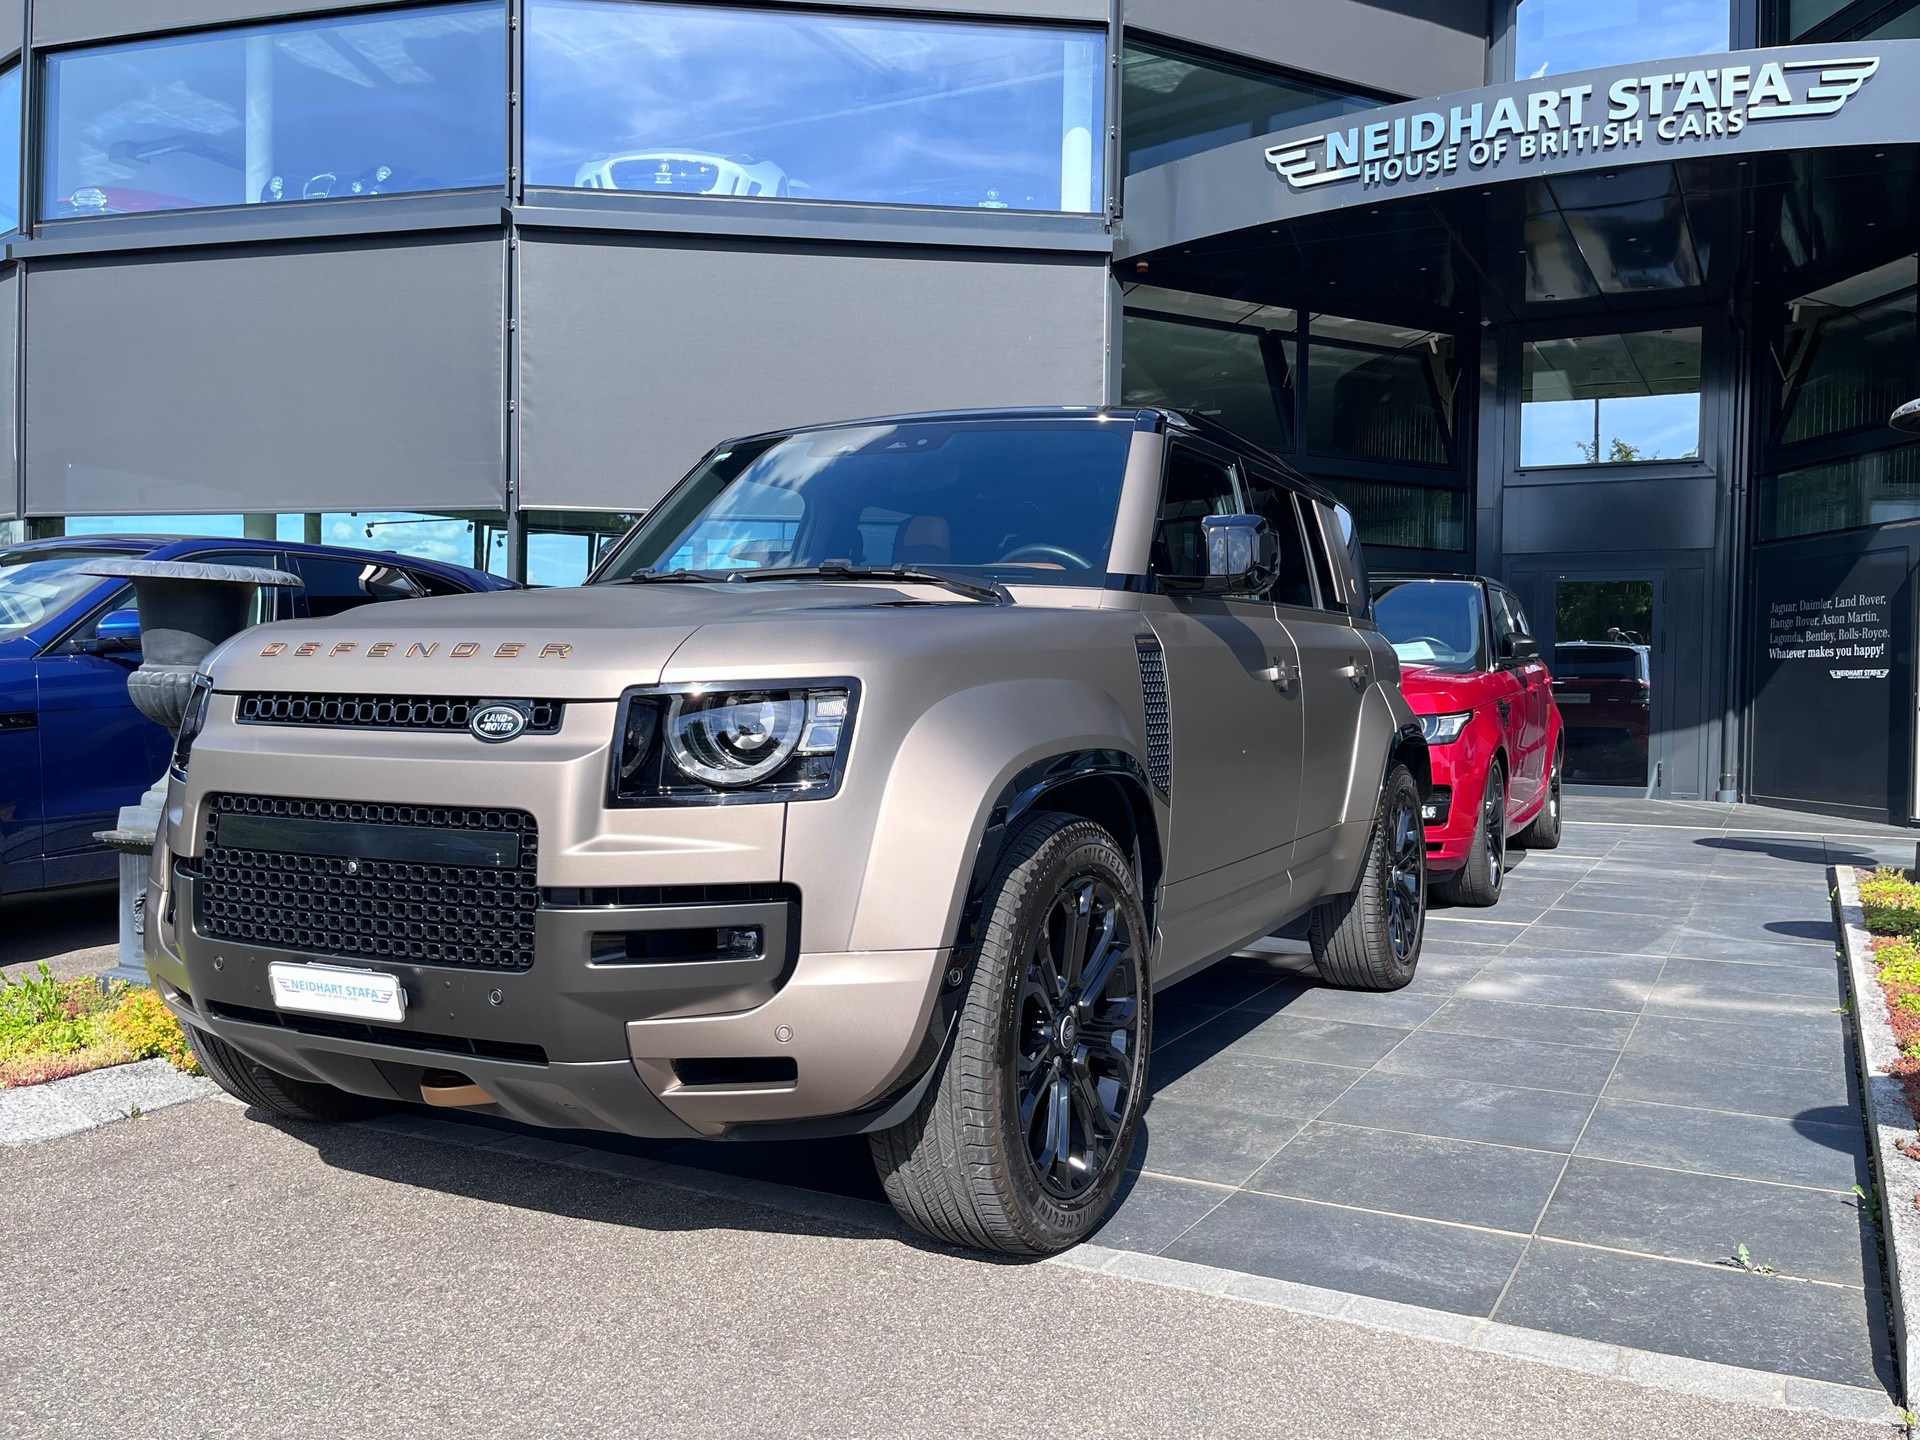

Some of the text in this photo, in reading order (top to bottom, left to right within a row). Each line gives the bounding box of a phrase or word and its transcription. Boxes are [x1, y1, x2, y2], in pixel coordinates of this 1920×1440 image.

[1327, 62, 1792, 169] NEIDHART STÄFA
[1364, 109, 1745, 184] HOUSE OF BRITISH CARS
[1770, 594, 1887, 615] Jaguar, Daimler, Land Rover,
[1770, 611, 1880, 630] Range Rover, Aston Martin,
[1769, 627, 1891, 646] Lagonda, Bentley, Rolls-Royce.
[259, 641, 574, 658] DEFENDER
[1769, 643, 1885, 659] Whatever makes you happy!
[484, 713, 508, 722] LAND
[484, 722, 514, 731] ROVER
[1083, 847, 1132, 889] MICHELIN
[290, 979, 343, 995] NEIDHART
